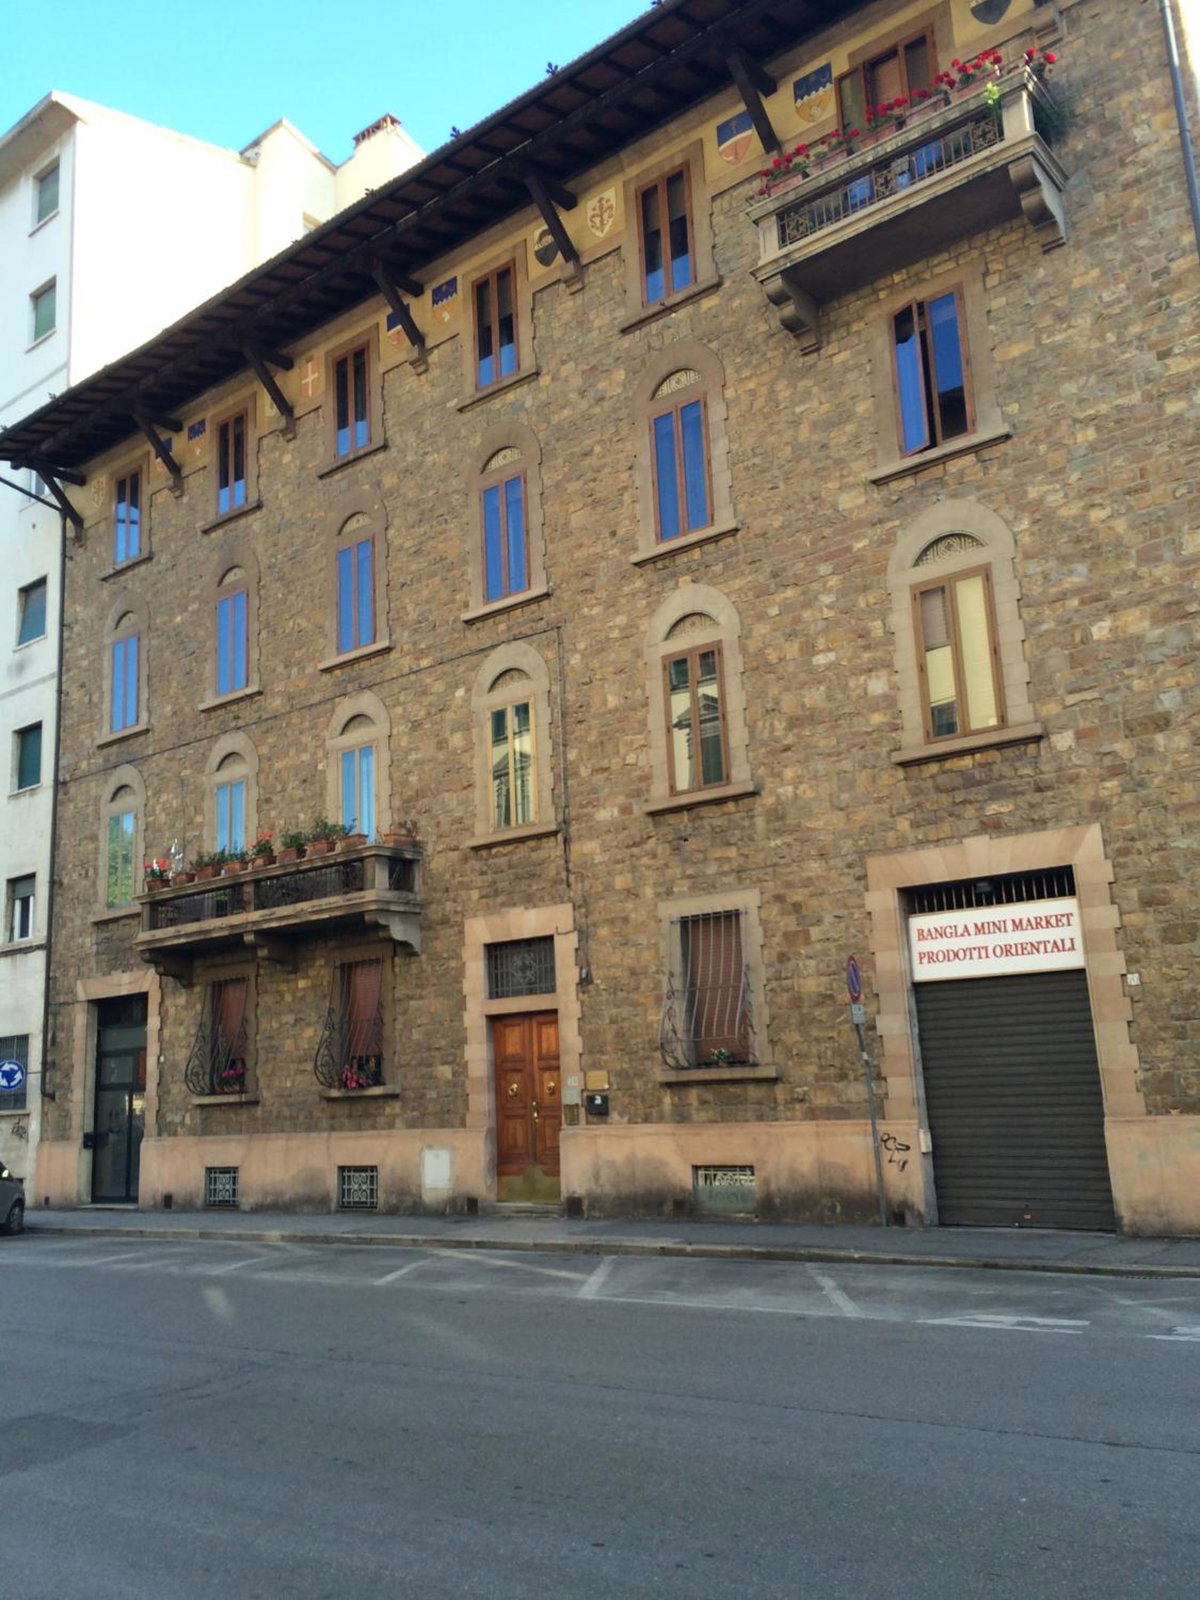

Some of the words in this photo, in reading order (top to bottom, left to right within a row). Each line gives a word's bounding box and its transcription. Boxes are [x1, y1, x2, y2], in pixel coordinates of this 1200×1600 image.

[916, 925, 971, 942] BANGLA
[973, 919, 1008, 936] MINI
[1011, 912, 1074, 931] MARKET
[917, 946, 990, 964] PRODOTTI
[992, 938, 1076, 958] ORIENTALI
